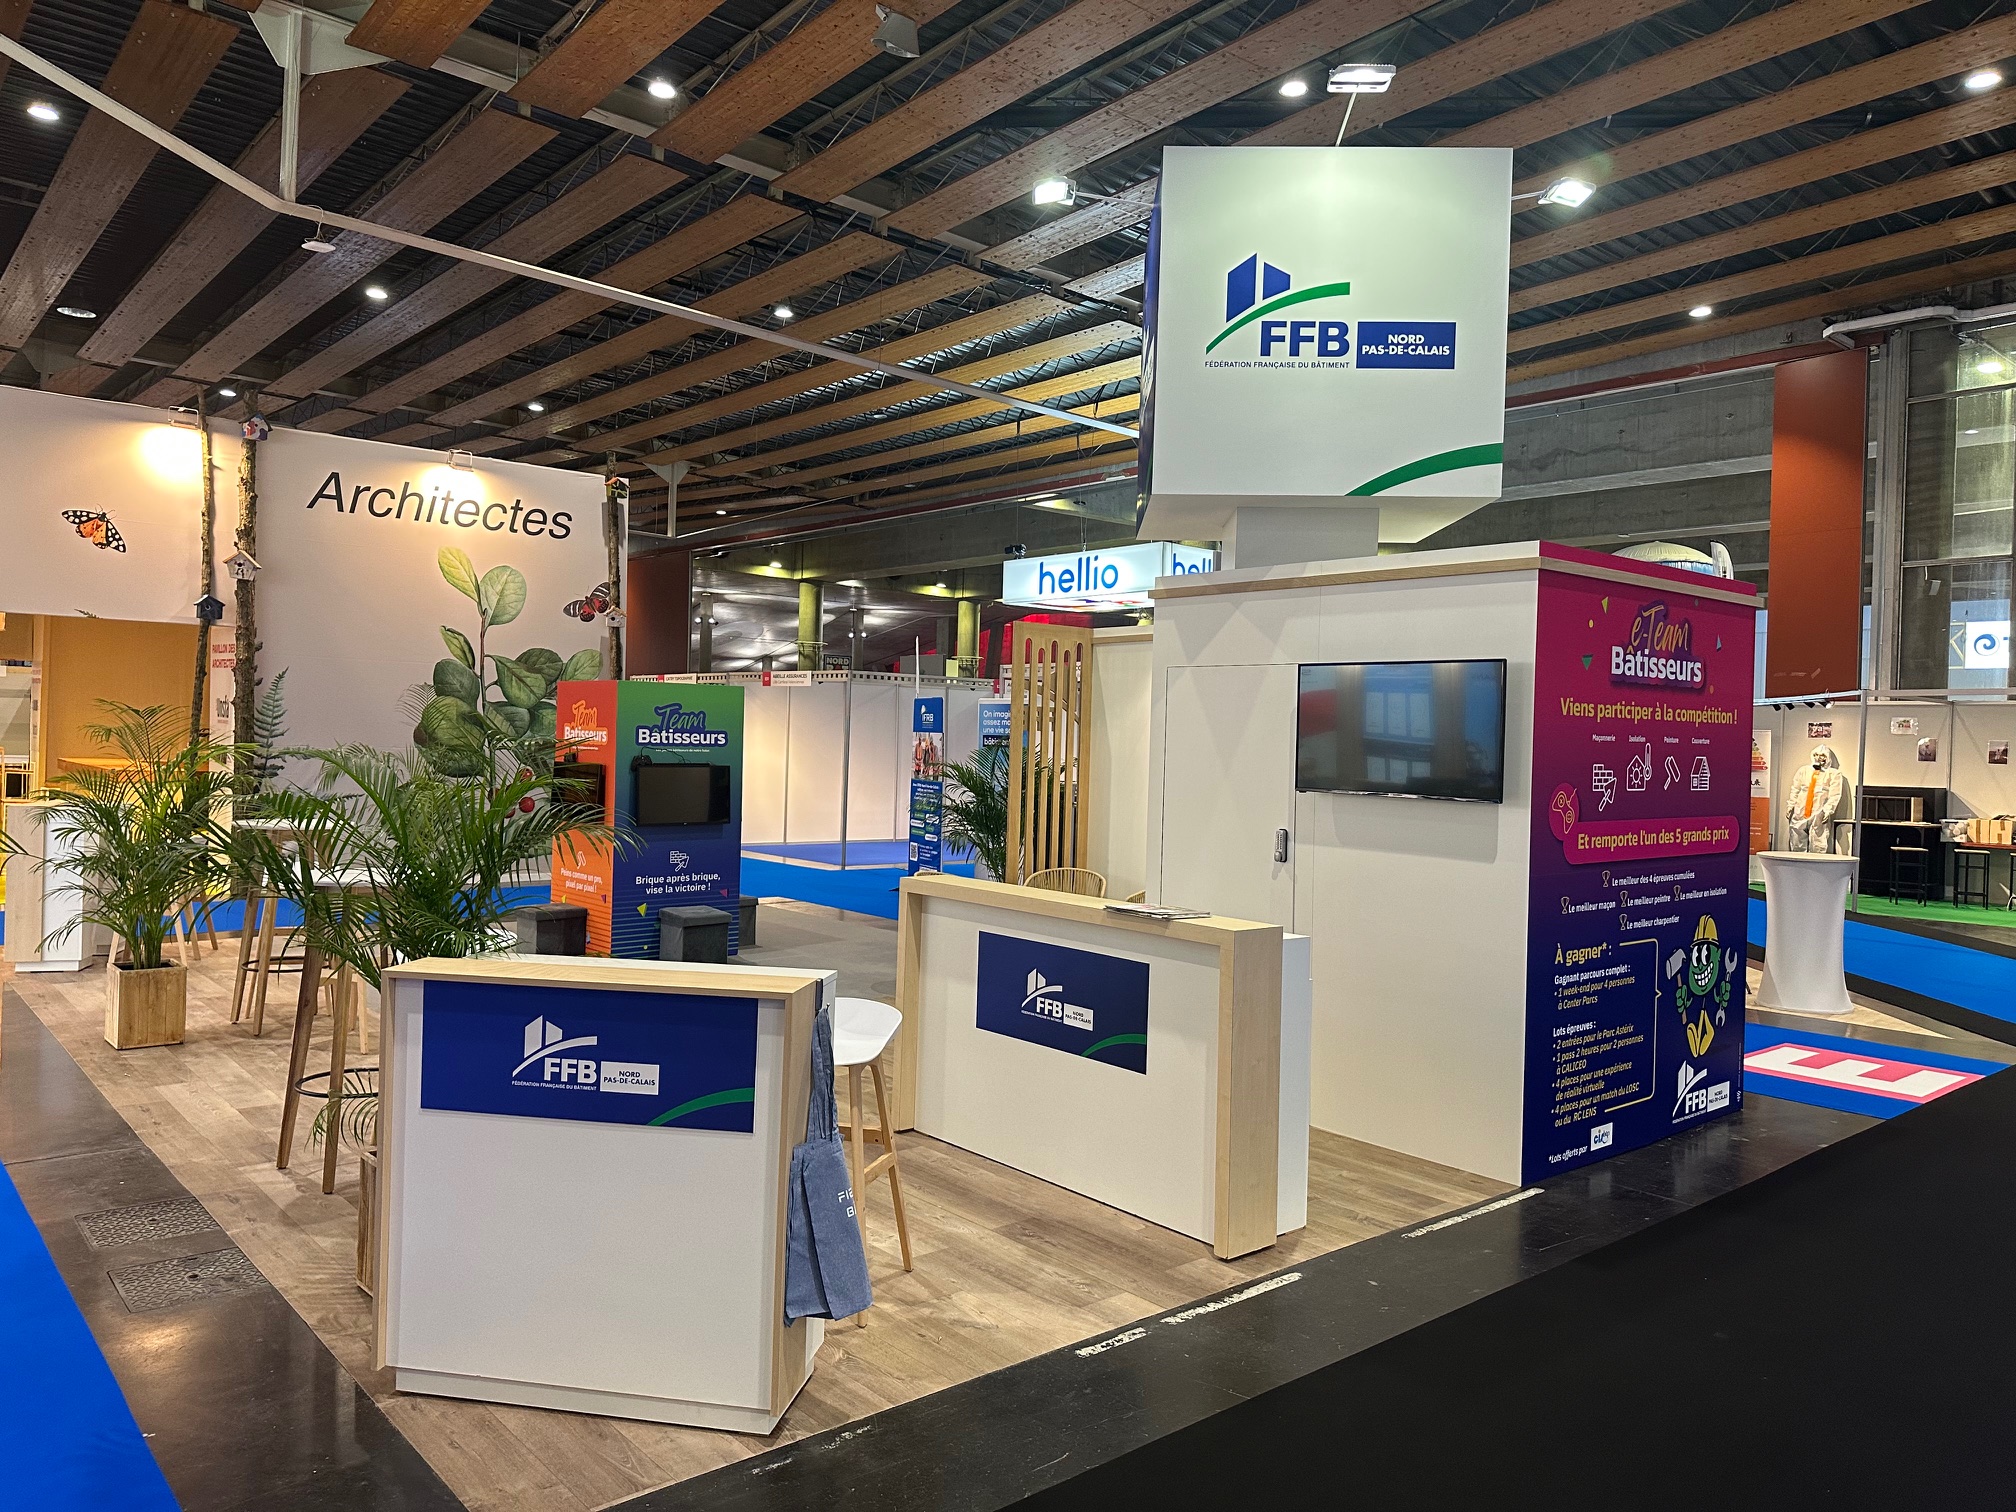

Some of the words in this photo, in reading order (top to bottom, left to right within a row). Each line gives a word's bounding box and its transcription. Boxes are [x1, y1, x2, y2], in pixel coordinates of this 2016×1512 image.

[1260, 321, 1350, 357] FFB
[1388, 334, 1425, 344] NORD
[1361, 345, 1450, 356] PAS-DE-CALAIS
[1204, 359, 1252, 368] FÉDÉRATION
[1253, 361, 1296, 370] FRANÇAISE
[1299, 361, 1309, 369] DU
[1311, 360, 1350, 369] BÂTIMENT
[306, 471, 573, 539] Architectes
[1038, 555, 1118, 595] hellio
[1631, 605, 1688, 653] e-Team
[826, 657, 849, 665] NORD
[1611, 645, 1702, 682] Bâtisseurs
[573, 702, 597, 727] Team
[657, 706, 704, 730] Team
[1560, 698, 1595, 718] Viens
[1597, 701, 1653, 724] participer
[1655, 702, 1662, 720] à
[1664, 704, 1673, 722] la
[1675, 705, 1733, 727] compétition
[638, 727, 726, 744] Bâtisseurs
[1592, 734, 1616, 742] Maçonnerie
[1578, 833, 1590, 849] Et
[1591, 834, 1638, 851] remporte
[1640, 830, 1656, 845] l'un
[1659, 828, 1674, 844] des
[1676, 829, 1681, 842] 5
[1683, 826, 1711, 846] grands
[1712, 825, 1729, 844] prix
[560, 868, 572, 877] Peins
[572, 871, 587, 880] comme
[635, 876, 664, 885] Brique
[666, 873, 690, 883] après
[692, 872, 721, 882] brique,
[1612, 877, 1618, 886] Le
[1619, 876, 1639, 886] meilleur
[1640, 875, 1648, 884] des
[1649, 874, 1653, 883] 4
[1653, 874, 1674, 884] épreuves
[1674, 870, 1695, 881] cumulées
[565, 880, 576, 889] pixel
[576, 881, 584, 890] par
[584, 883, 595, 892] pixel
[646, 885, 663, 894] vise
[665, 884, 673, 893] la
[675, 883, 706, 893] victoire
[1680, 891, 1685, 900] Le
[1686, 889, 1703, 899] meilleur
[1704, 888, 1710, 897] en
[1710, 886, 1727, 896] isolation
[1569, 904, 1574, 913] Le
[1575, 902, 1598, 912] meilleur
[1599, 900, 1616, 912] maçon
[1628, 898, 1633, 906] Le
[1634, 896, 1654, 906] meilleur
[1654, 894, 1671, 905] peintre
[1627, 920, 1632, 929] Le
[1633, 918, 1653, 929] meilleur
[1654, 915, 1680, 926] charpentier
[1555, 943, 1563, 964] À
[1554, 972, 1579, 986] Gagnant
[1580, 969, 1605, 982] parcours
[1605, 964, 1627, 976] complet
[1563, 982, 1590, 996] week-end
[1590, 981, 1604, 993] pour
[1604, 979, 1608, 988] 4
[1608, 976, 1635, 990] personnes
[1036, 997, 1062, 1017] FFB
[1558, 1000, 1563, 1010] à
[1563, 998, 1582, 1009] Center
[1582, 996, 1598, 1005] Parcs
[1553, 1027, 1566, 1037] Lots
[1567, 1021, 1593, 1035] épreuves
[1556, 1040, 1561, 1049] 2
[1562, 1035, 1583, 1048] entrées
[1583, 1033, 1596, 1045] pour
[1597, 1031, 1602, 1040] le
[1602, 1029, 1615, 1039] Parc
[1615, 1023, 1634, 1035] Astérix
[1561, 1050, 1575, 1063] pass
[1576, 1048, 1580, 1057] 2
[1580, 1045, 1600, 1056] heures
[1600, 1042, 1613, 1054] pour
[1613, 1039, 1617, 1048] 2
[1617, 1034, 1644, 1049] personnes
[544, 1057, 597, 1083] FFB
[1555, 1079, 1560, 1087] 4
[1560, 1076, 1579, 1089] places
[1580, 1071, 1593, 1083] pour
[1593, 1069, 1604, 1079] une
[1604, 1061, 1632, 1076] expérience
[1556, 1065, 1561, 1075] à
[1562, 1059, 1587, 1074] CALICEO
[540, 1082, 566, 1090] FRANÇAISE
[603, 1077, 656, 1086] PAS-DE-CALAIS
[1555, 1091, 1563, 1101] de
[1564, 1085, 1582, 1099] réalité
[1582, 1079, 1605, 1093] virtuelle
[1555, 1105, 1559, 1114] 4
[1560, 1102, 1578, 1115] places
[1579, 1097, 1592, 1109] pour
[1592, 1095, 1600, 1103] un
[1601, 1089, 1617, 1101] match
[1618, 1086, 1625, 1095] du
[1626, 1082, 1639, 1093] LOSC
[1685, 1089, 1707, 1114] FFB
[1554, 1118, 1563, 1127] ou
[1563, 1115, 1571, 1125] du
[1573, 1111, 1581, 1122] RC
[1582, 1106, 1597, 1119] LENS
[1562, 1147, 1578, 1161] offerts
[1579, 1145, 1588, 1156] par
